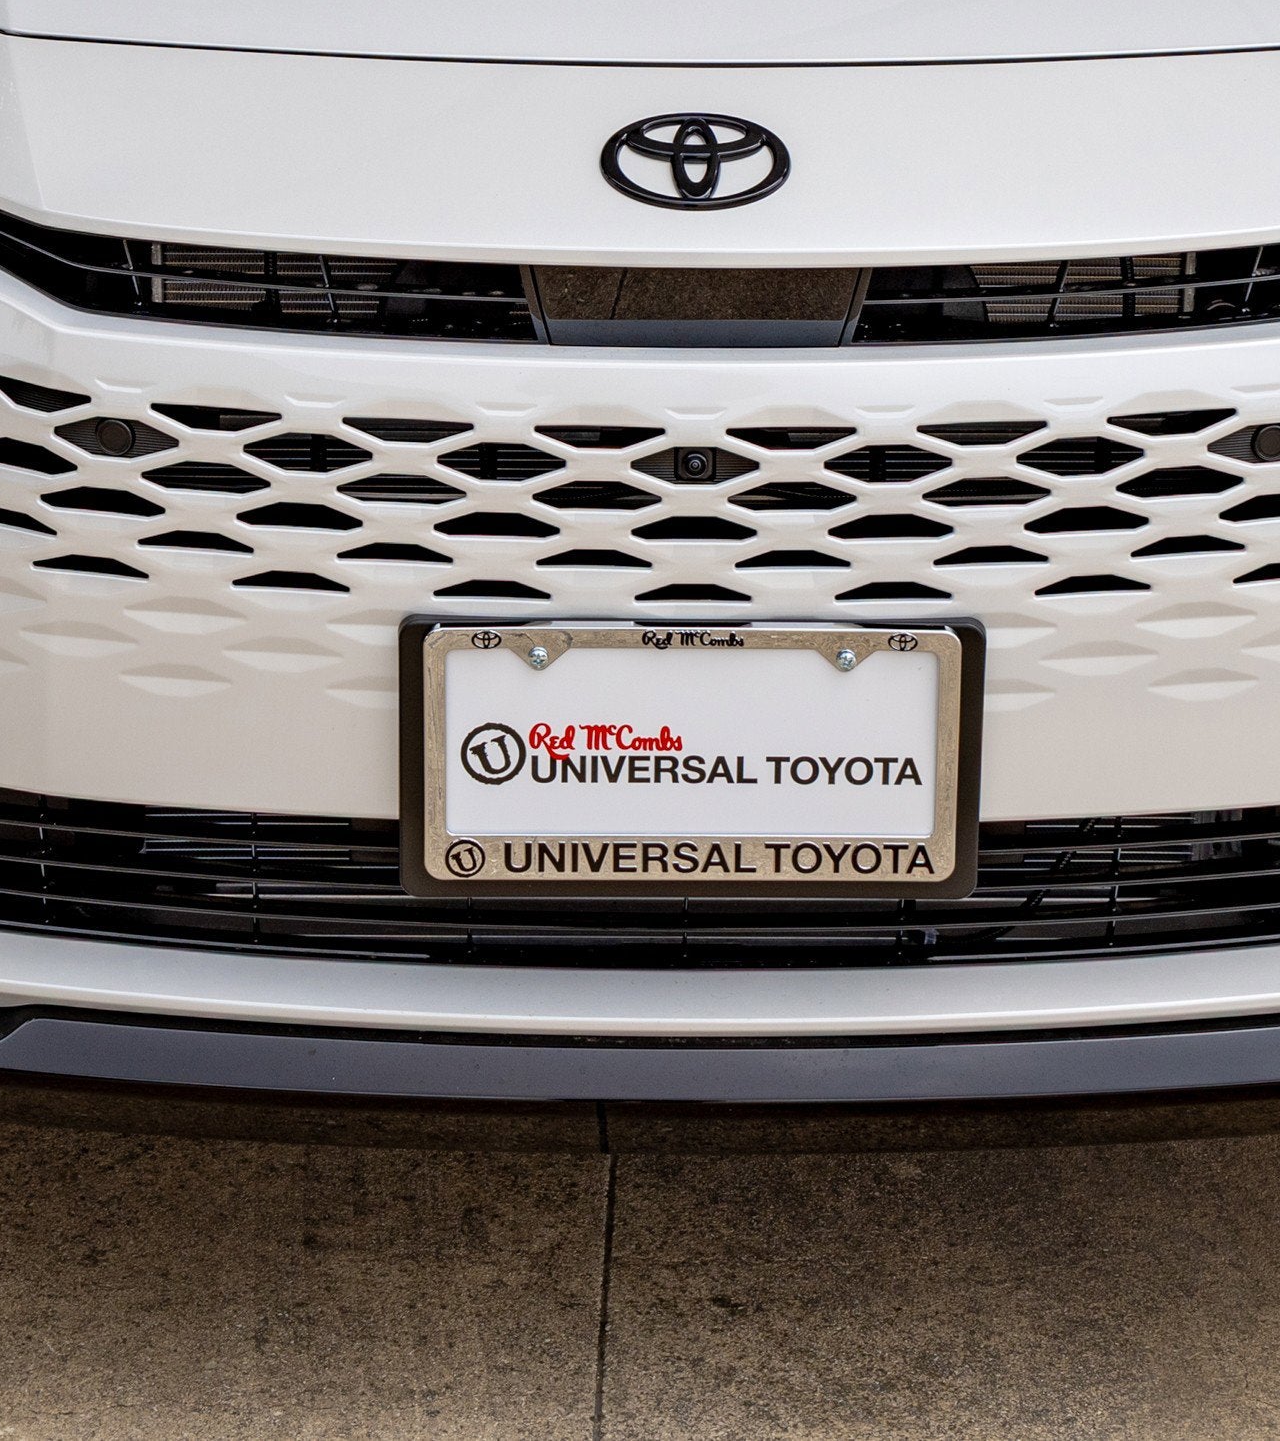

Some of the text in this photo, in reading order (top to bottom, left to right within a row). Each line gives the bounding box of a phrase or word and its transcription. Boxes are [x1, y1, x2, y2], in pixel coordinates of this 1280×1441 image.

[642, 630, 745, 650] Red McCombs
[529, 722, 683, 760] Red McCombs
[531, 755, 757, 784] UNIVERSAL
[766, 757, 923, 786] TOYOTA
[503, 842, 756, 874] UNIVERSAL
[765, 843, 936, 875] TOYOTA
